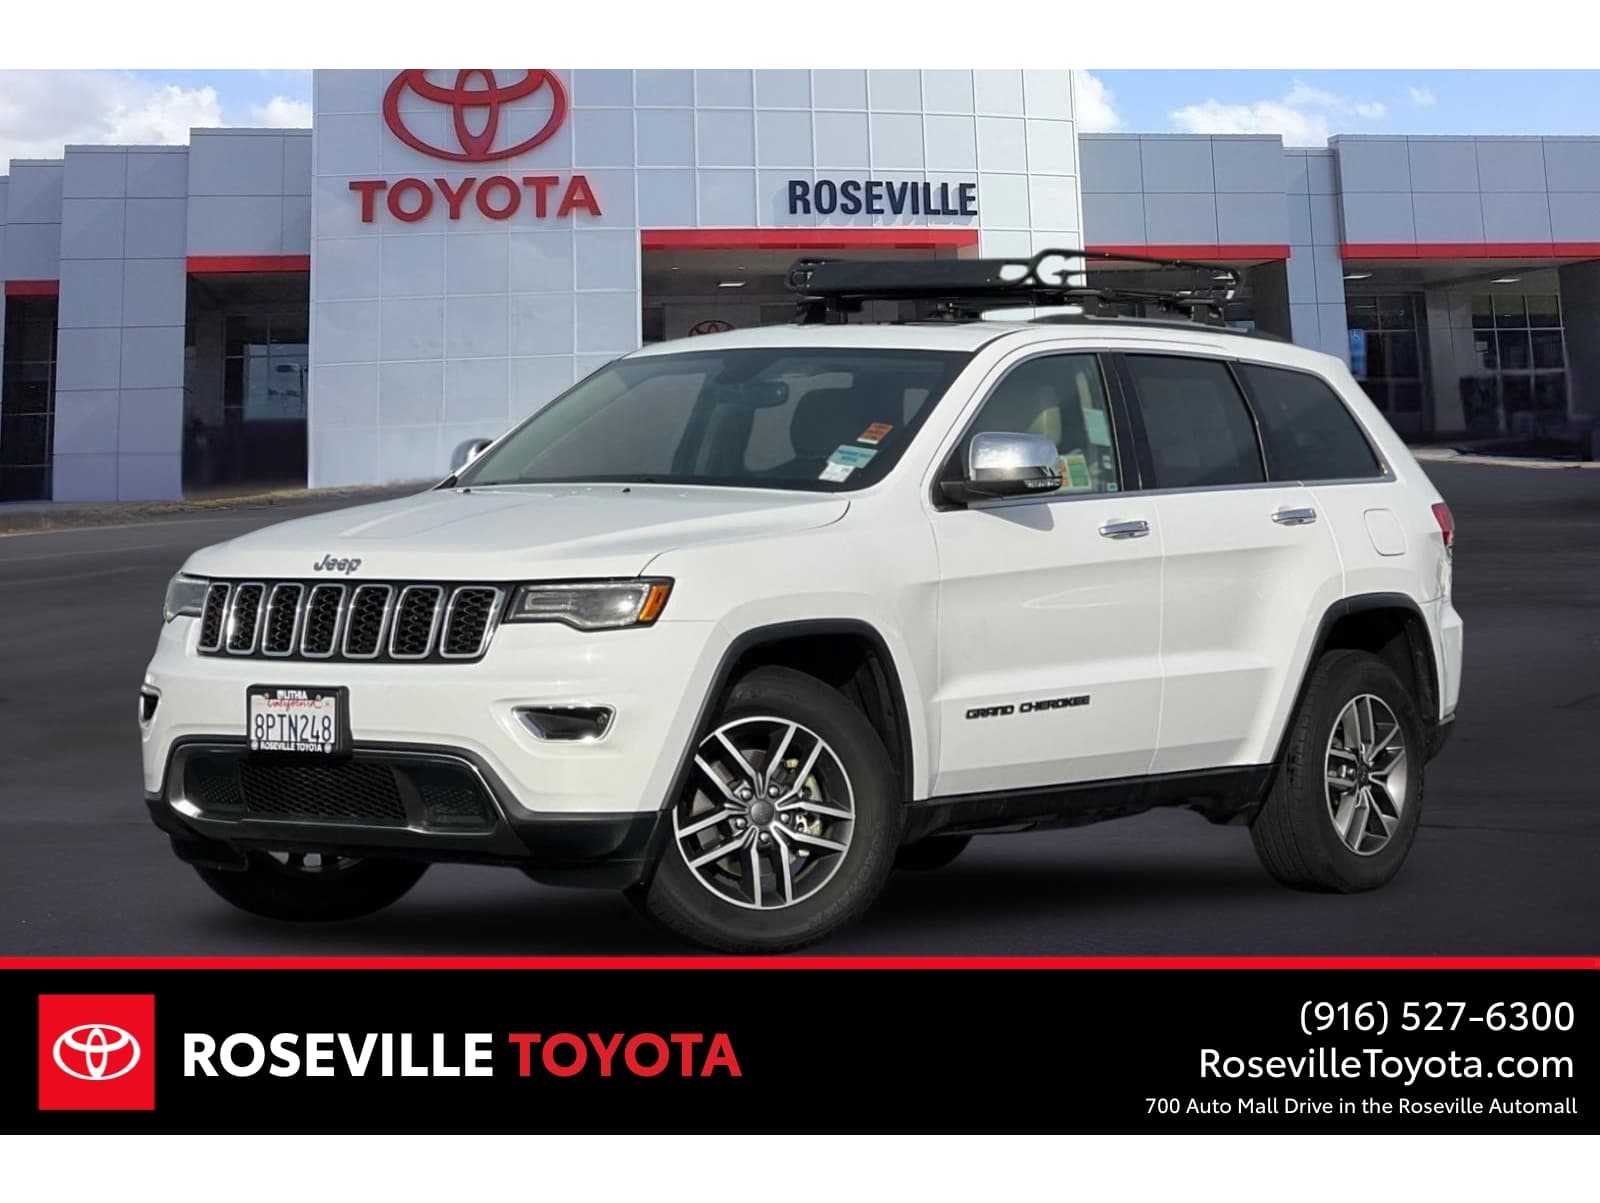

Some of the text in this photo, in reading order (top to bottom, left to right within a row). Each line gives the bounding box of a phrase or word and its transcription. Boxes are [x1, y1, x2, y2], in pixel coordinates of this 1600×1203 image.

[349, 175, 602, 223] TOYOTA
[788, 180, 978, 216] ROSEVILLE
[313, 554, 361, 575] Jeep
[966, 695, 1090, 719] GRAND CHEROKEE
[255, 713, 332, 743] 8PTN248
[260, 741, 322, 752] ROSEVILLE TOYOTA
